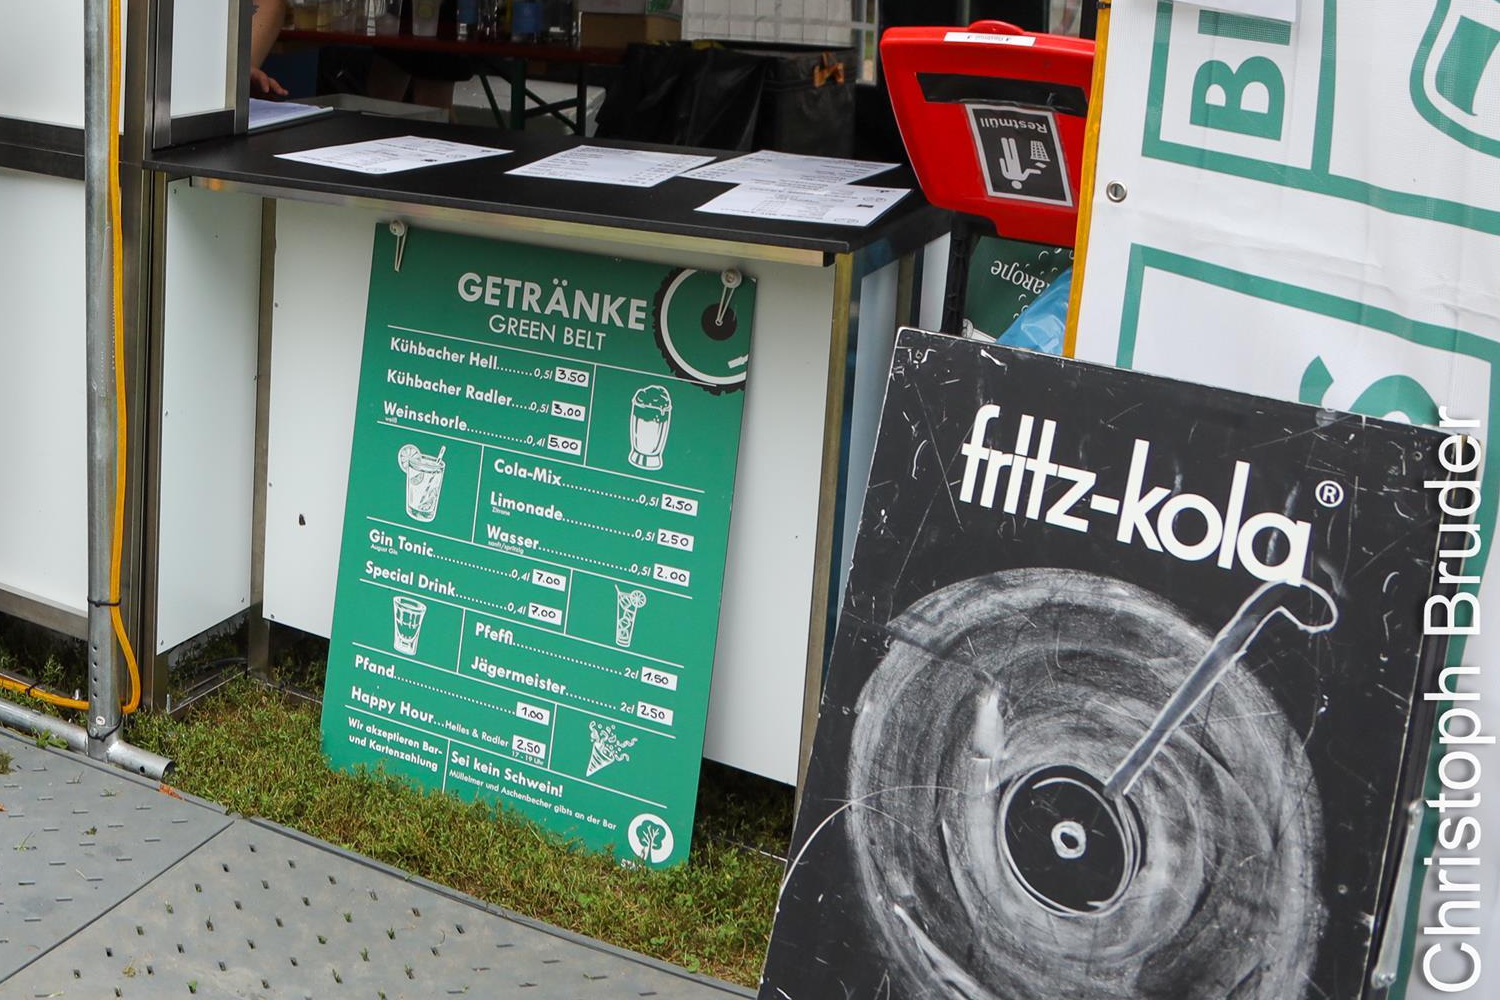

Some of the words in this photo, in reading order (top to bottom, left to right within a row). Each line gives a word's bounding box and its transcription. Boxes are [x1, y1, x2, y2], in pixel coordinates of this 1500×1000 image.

[980, 117, 1048, 134] Restmüll
[457, 272, 648, 331] GETRÄNKE
[489, 314, 556, 343] GREEN
[563, 326, 607, 351] BELT
[390, 337, 465, 363] Kühbacher
[469, 352, 498, 370] Hell
[387, 369, 461, 396] Kühbacher
[465, 384, 513, 407] Radler
[384, 400, 468, 431] Weinschorle
[493, 459, 562, 486] Cola-Mix
[490, 491, 563, 521] Limonade
[959, 404, 1312, 588] fritz-kola
[369, 528, 393, 547] Gin
[398, 535, 434, 557] Tonic
[487, 523, 539, 550] Wasser
[365, 560, 414, 585] Special
[418, 574, 457, 597] Drink
[354, 654, 395, 679] Pfand
[475, 621, 513, 646] Pfeffi
[623, 667, 639, 680] 2cl
[470, 656, 567, 696] Jägermeister
[620, 702, 635, 714] 2cl
[351, 685, 396, 714] Happy
[399, 700, 435, 724] Hour
[444, 719, 470, 736] Helles
[471, 729, 479, 739] &
[481, 731, 509, 748] Radler
[348, 716, 364, 730] Wir
[365, 724, 420, 749] akzeptieren
[422, 740, 443, 755] Bar-
[348, 734, 367, 747] und
[369, 739, 439, 772] Kartenzahlung
[451, 750, 470, 768] Sei
[473, 757, 500, 777] kein
[504, 767, 564, 798] Schwein!
[449, 768, 484, 787] Mülleimer
[485, 782, 500, 792] und
[500, 786, 552, 809] Aschenbecher
[553, 804, 573, 817] gibts
[574, 811, 585, 820] an
[586, 814, 601, 825] der
[602, 818, 617, 831] Bar
